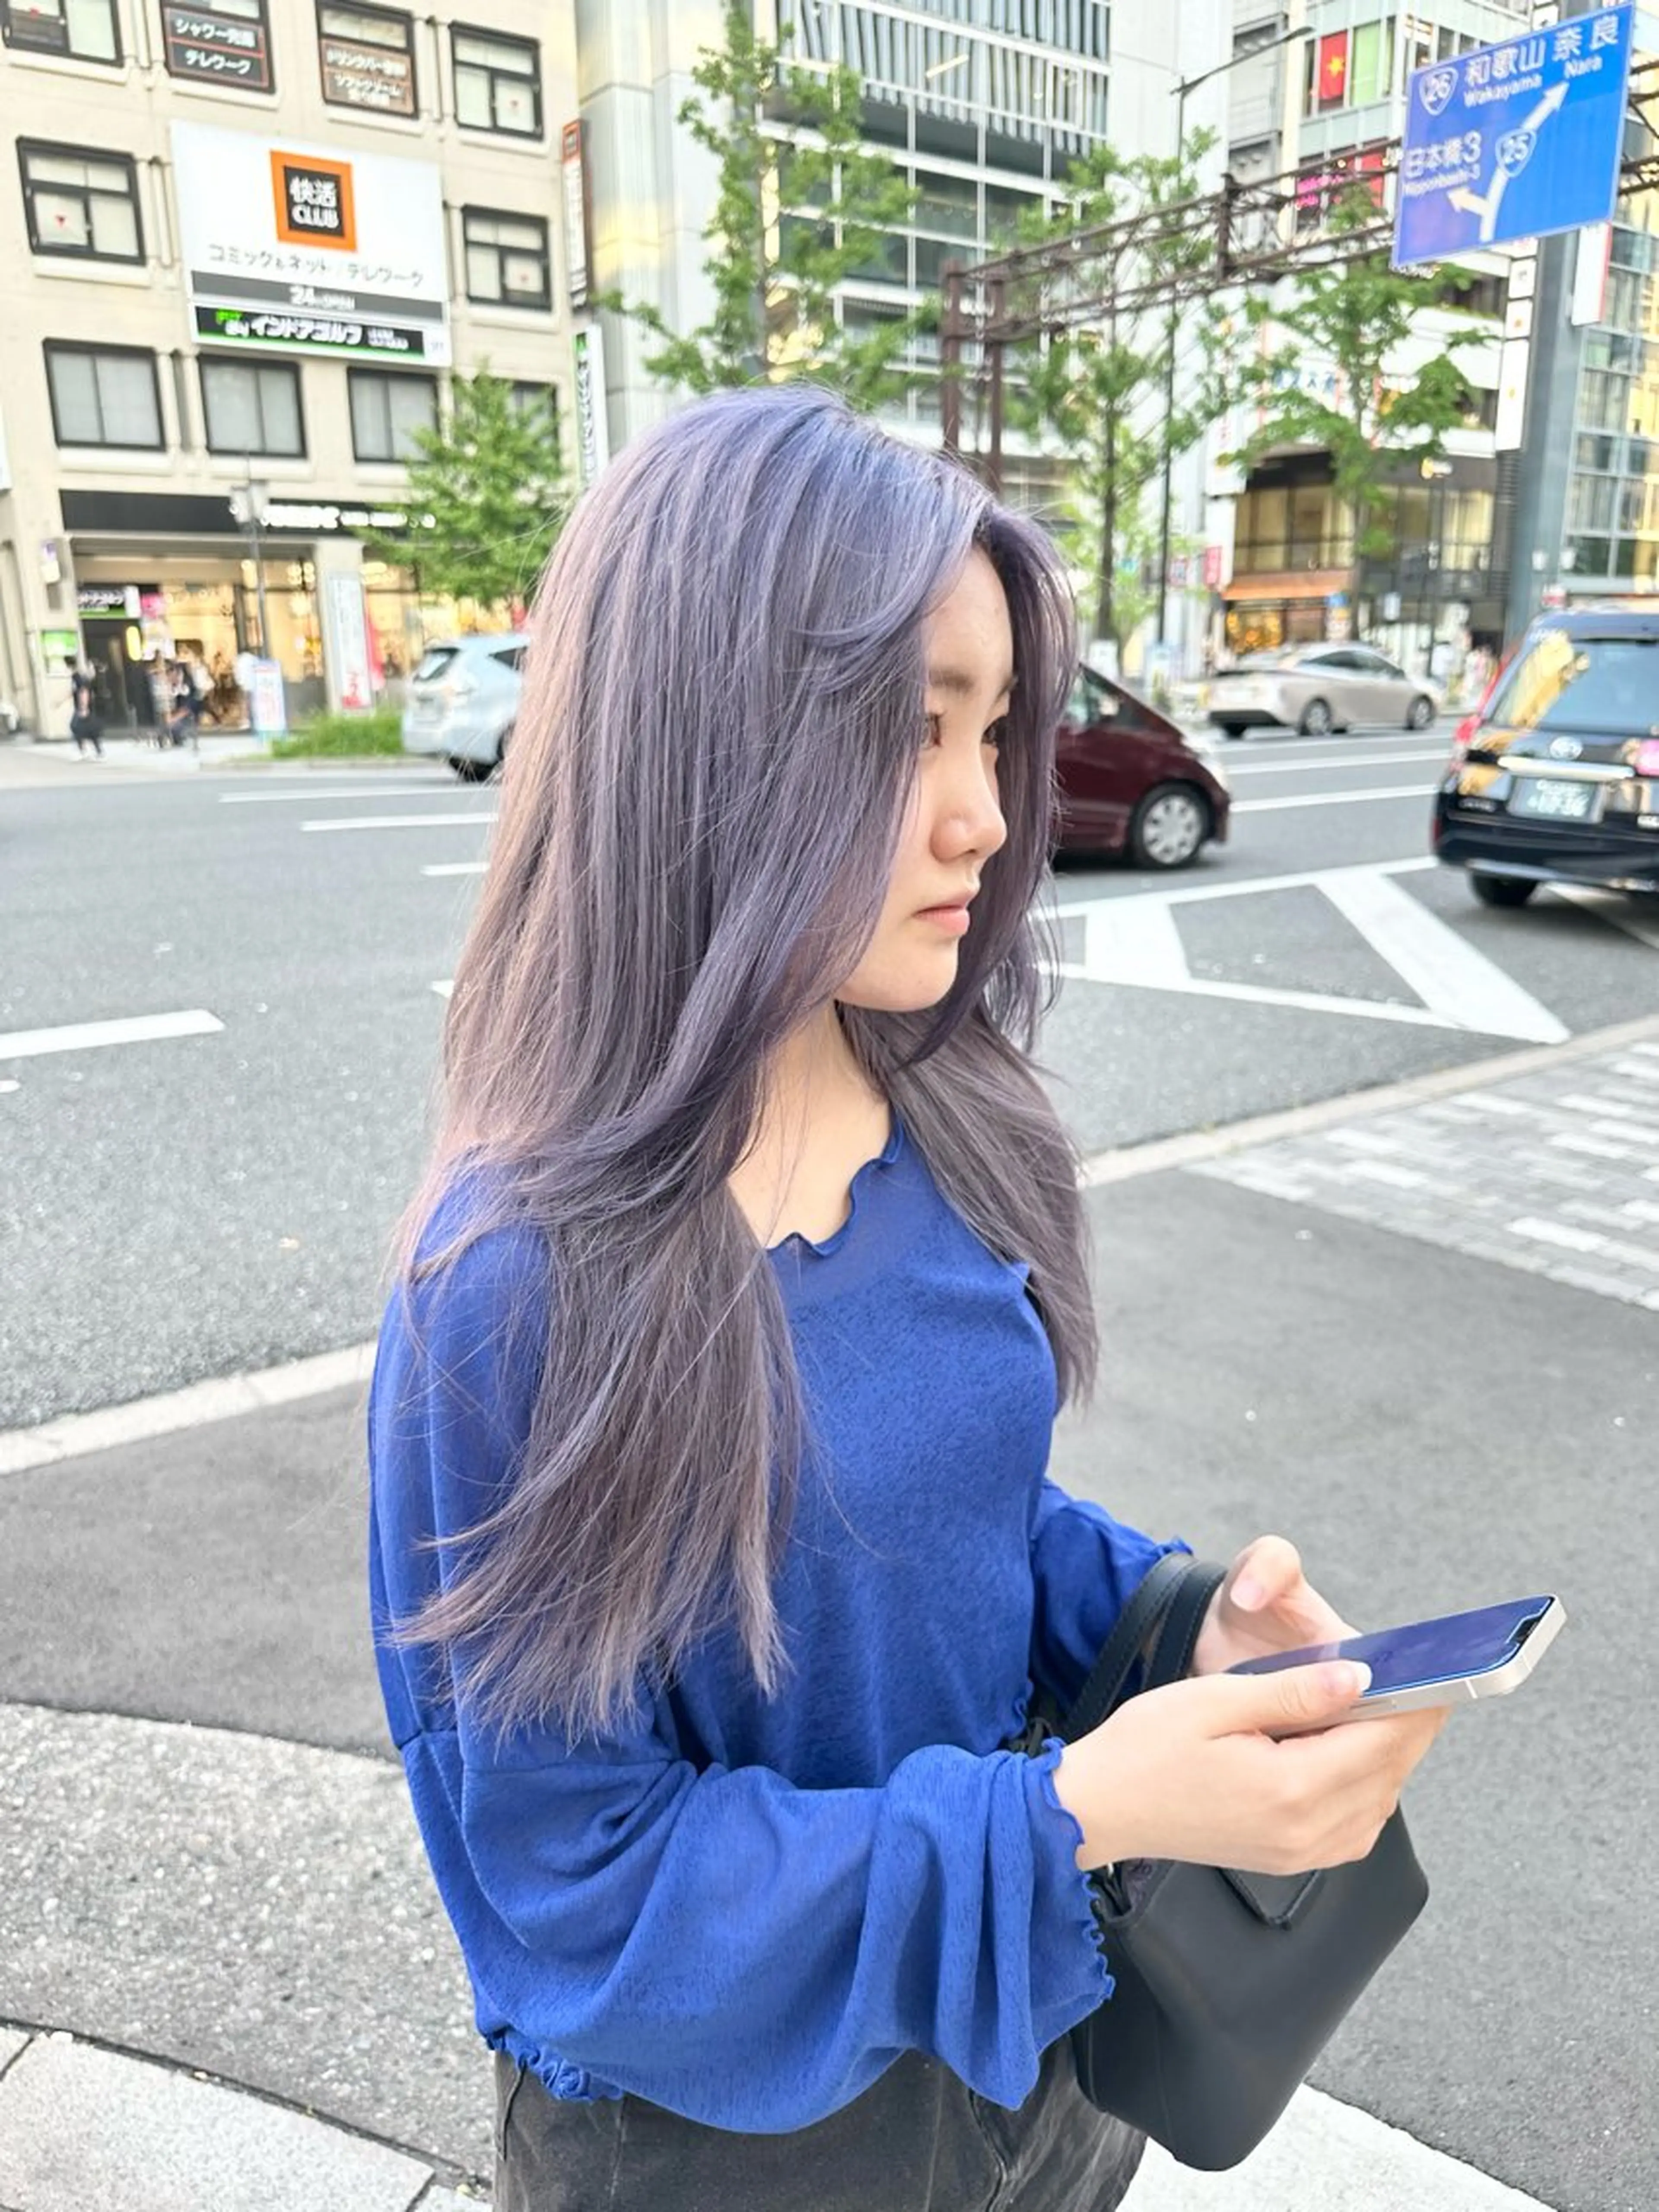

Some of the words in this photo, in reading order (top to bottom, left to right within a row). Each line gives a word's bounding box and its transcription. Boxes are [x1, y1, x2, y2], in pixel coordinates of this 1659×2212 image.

[185, 50, 251, 75] テレワーク
[1464, 38, 1546, 87] 和歌山
[1551, 14, 1618, 61] 奈良
[1564, 54, 1603, 79] Nara
[1427, 73, 1452, 102] 26
[1463, 73, 1543, 108] Wakayama
[1503, 135, 1528, 163] 25
[290, 176, 337, 208] 快活
[292, 204, 339, 229] CLUB
[347, 263, 424, 288] テレワーク
[251, 315, 362, 345] インドアゴルフ
